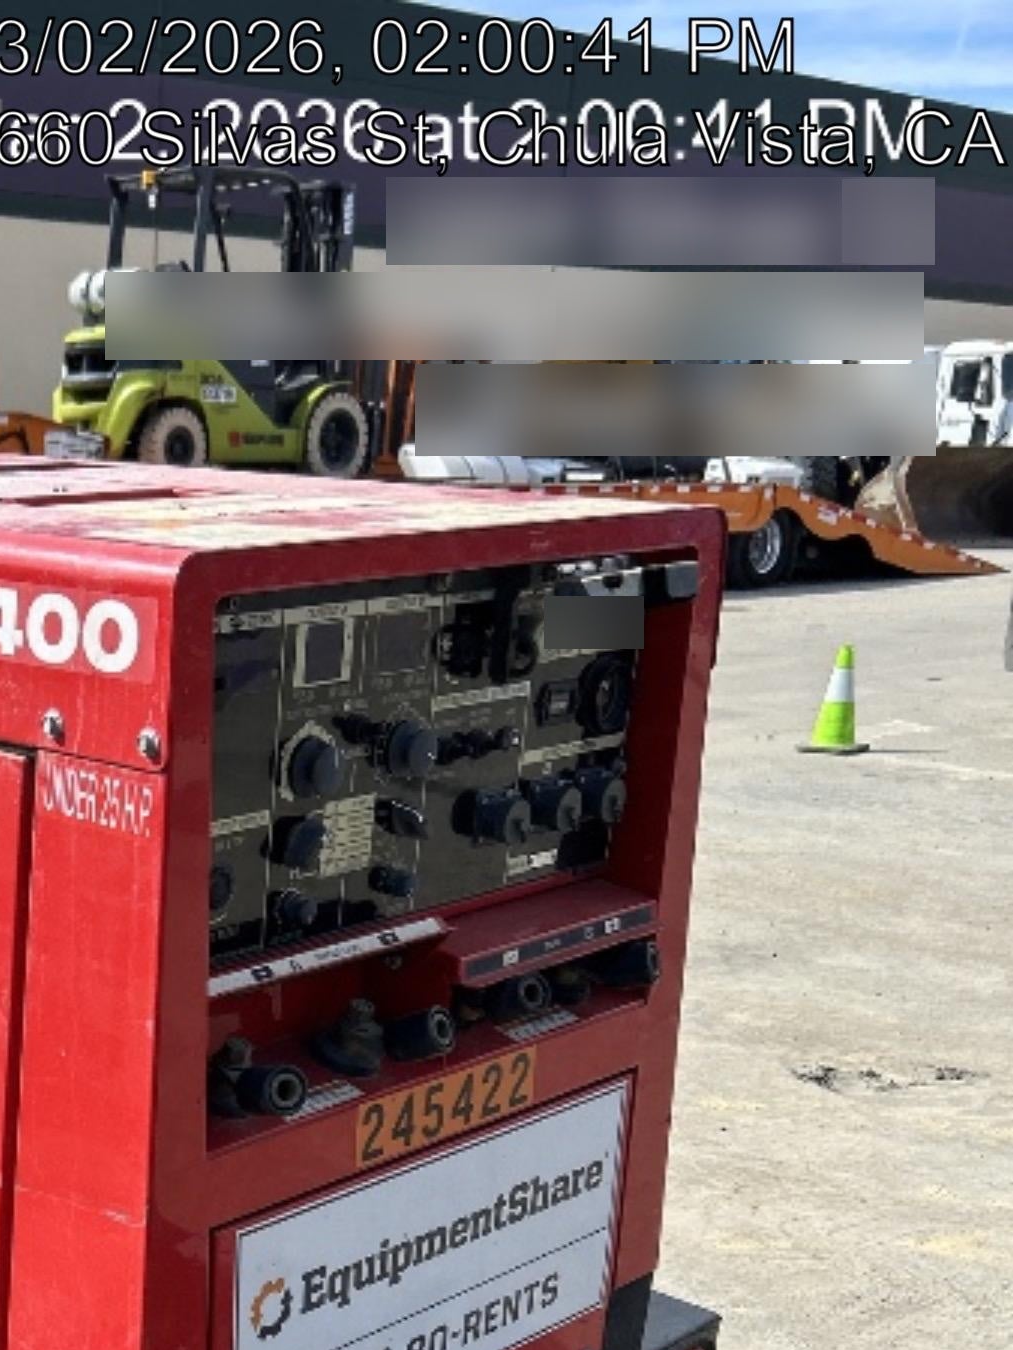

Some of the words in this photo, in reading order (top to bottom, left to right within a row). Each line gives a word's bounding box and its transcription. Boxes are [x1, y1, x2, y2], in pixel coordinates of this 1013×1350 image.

[42, 761, 97, 823] UNDER
[100, 775, 119, 829] 25
[361, 1053, 529, 1162] 245422
[300, 1159, 604, 1314] EquipmentShare
